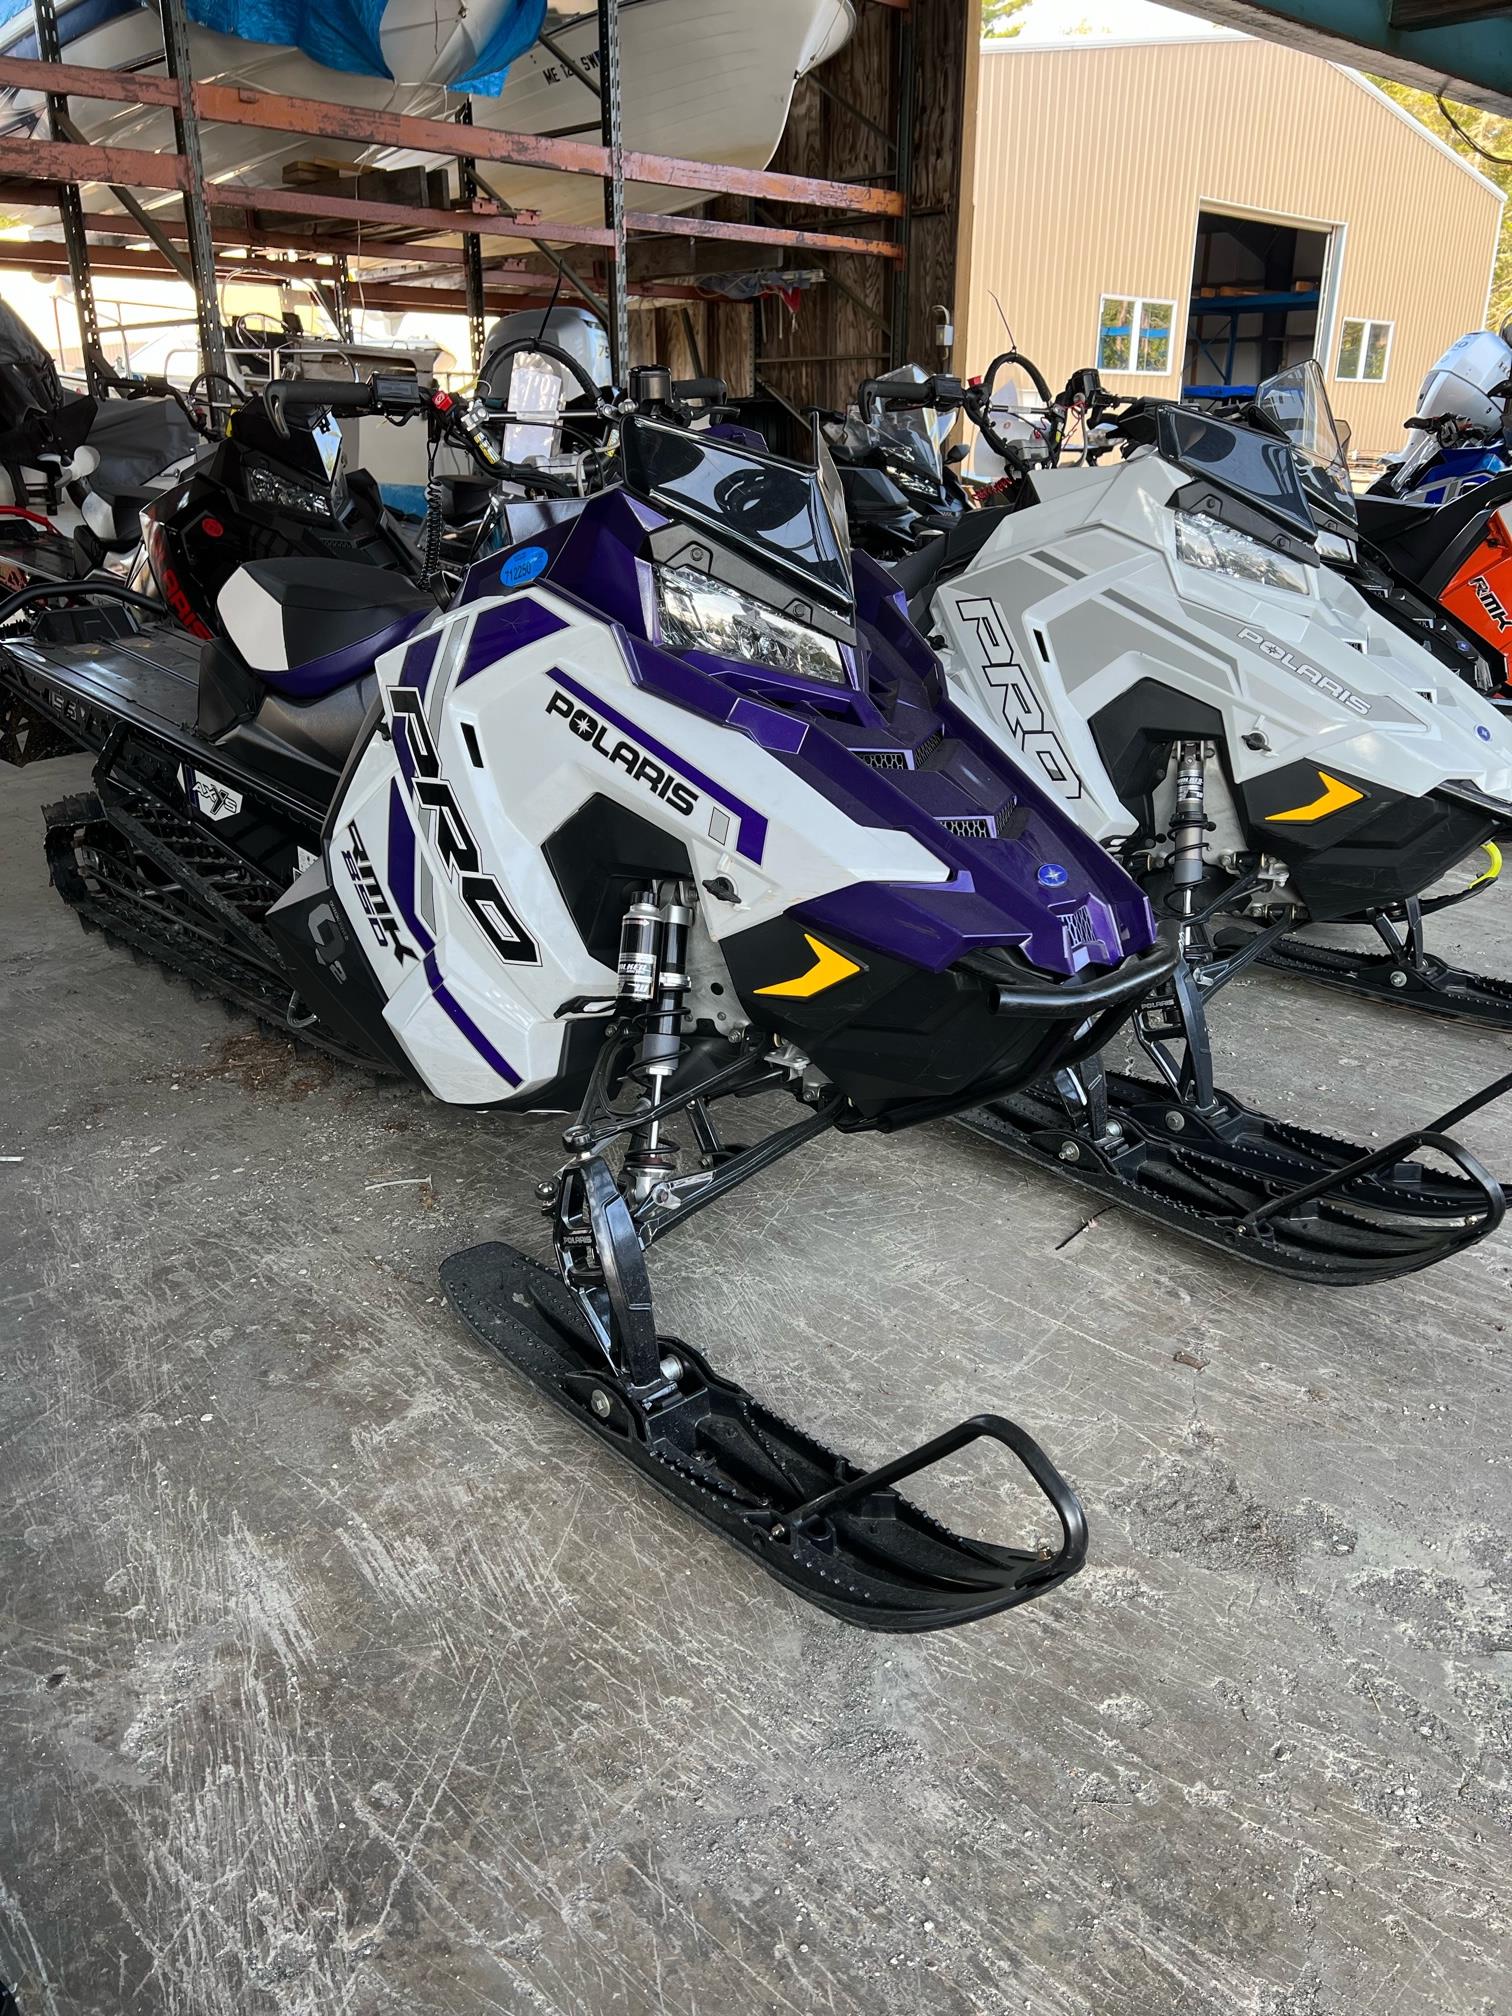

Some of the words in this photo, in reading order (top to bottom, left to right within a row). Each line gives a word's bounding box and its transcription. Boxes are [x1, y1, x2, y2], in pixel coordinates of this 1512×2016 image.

[542, 67, 560, 85] ME
[1468, 575, 1512, 633] RMK
[955, 597, 1082, 799] PRO
[1237, 626, 1372, 715] POLARIS
[192, 781, 238, 816] AXYS
[545, 689, 700, 816] POLARIS
[386, 686, 543, 967] PRO
[341, 850, 389, 947] 850
[348, 819, 421, 968] RMK
[562, 1236, 592, 1244] POLARIS
